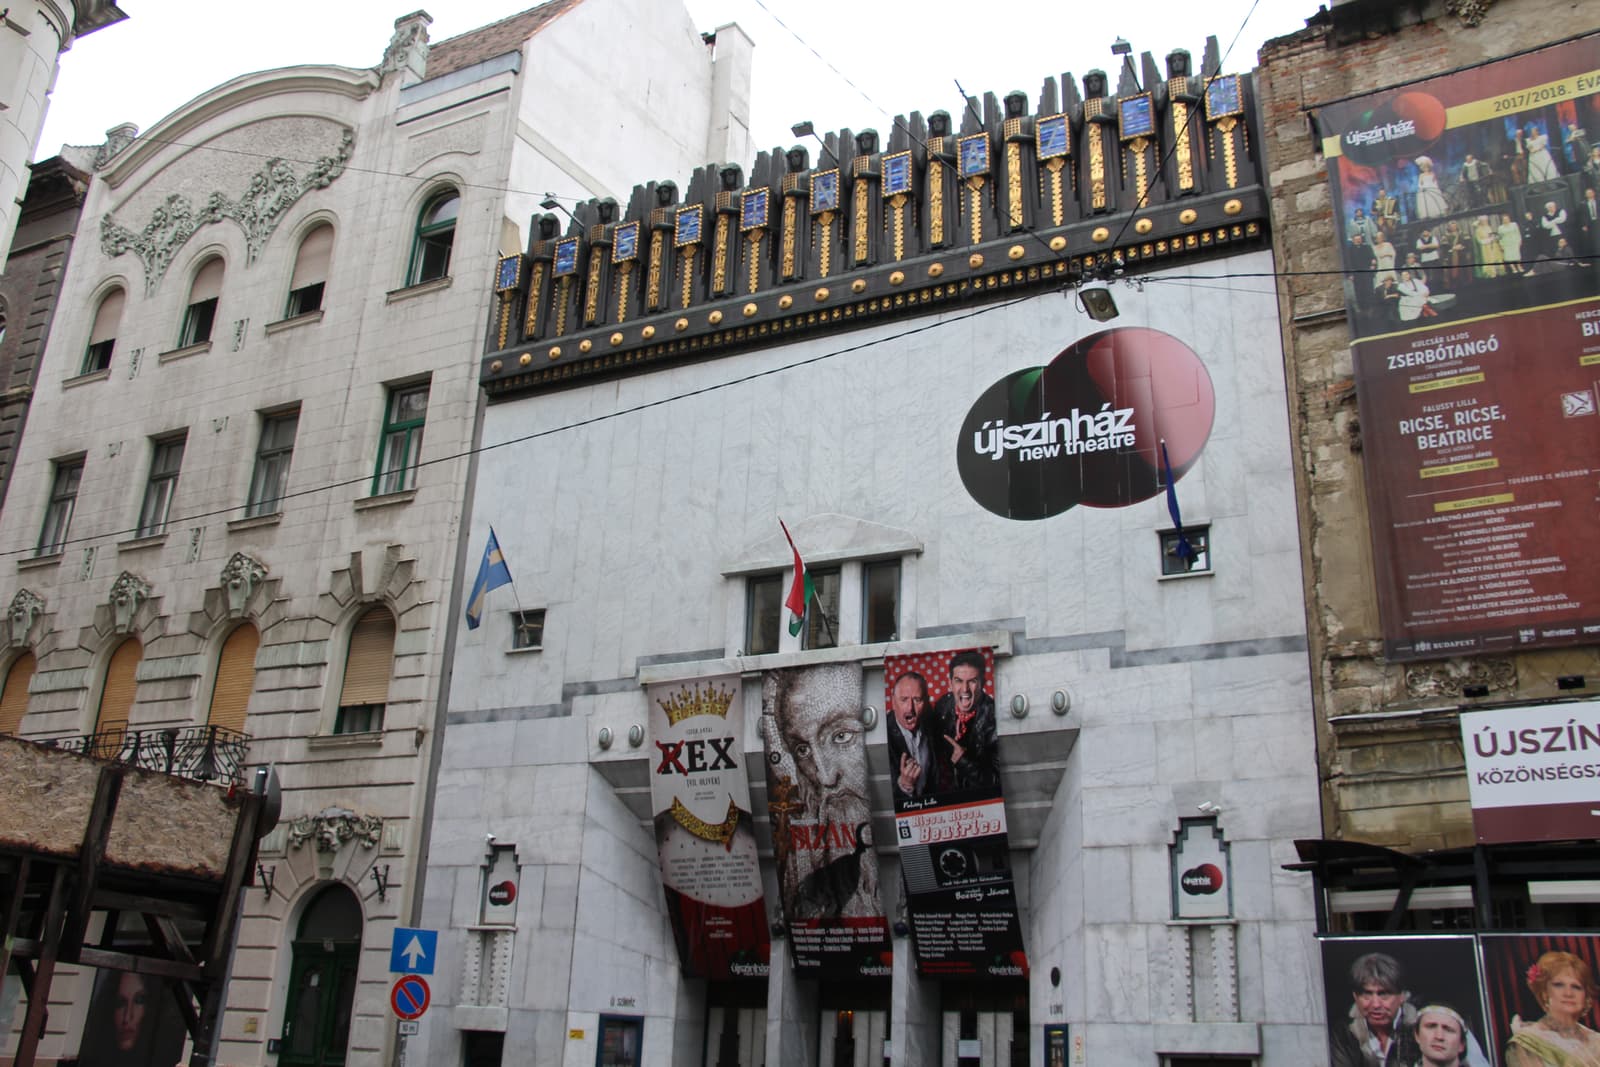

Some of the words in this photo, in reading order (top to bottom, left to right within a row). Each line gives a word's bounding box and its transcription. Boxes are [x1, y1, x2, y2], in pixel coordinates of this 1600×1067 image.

[1446, 332, 1470, 342] LAJOS
[1582, 321, 1600, 336] BI
[1387, 334, 1500, 370] ZSERBÓTANGÓ
[1423, 402, 1455, 413] FALUSSY
[1456, 398, 1478, 407] LILLA
[974, 402, 1136, 461] újszínház
[1399, 414, 1450, 435] RICSE,
[1454, 405, 1506, 426] RICSE,
[1019, 445, 1059, 462] new
[1064, 432, 1136, 456] theatre
[1417, 425, 1493, 450] BEATRICE
[1473, 718, 1600, 758] ÚJSZÍN
[920, 819, 1001, 843] Beatrice
